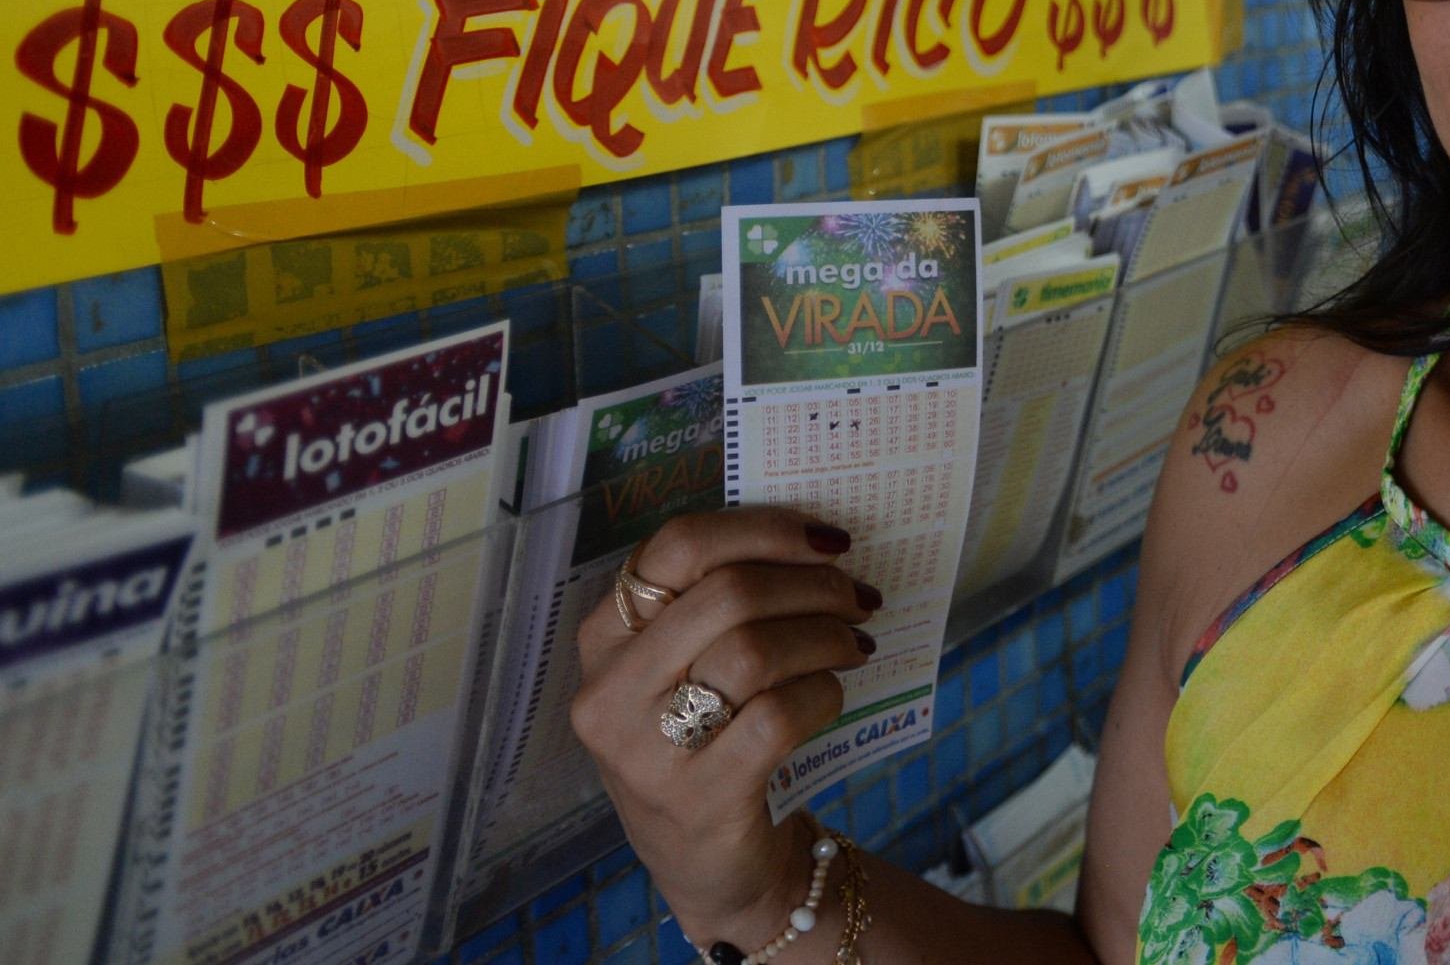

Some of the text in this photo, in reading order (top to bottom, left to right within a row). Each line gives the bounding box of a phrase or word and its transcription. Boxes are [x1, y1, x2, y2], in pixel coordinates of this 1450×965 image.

[786, 251, 939, 290] mega da
[760, 284, 961, 349] VIRADA
[847, 340, 885, 356] 31/12
[282, 373, 491, 482] lotofácil
[622, 421, 701, 464] mega
[792, 740, 850, 780] loterias
[855, 708, 916, 747] CAIXA
